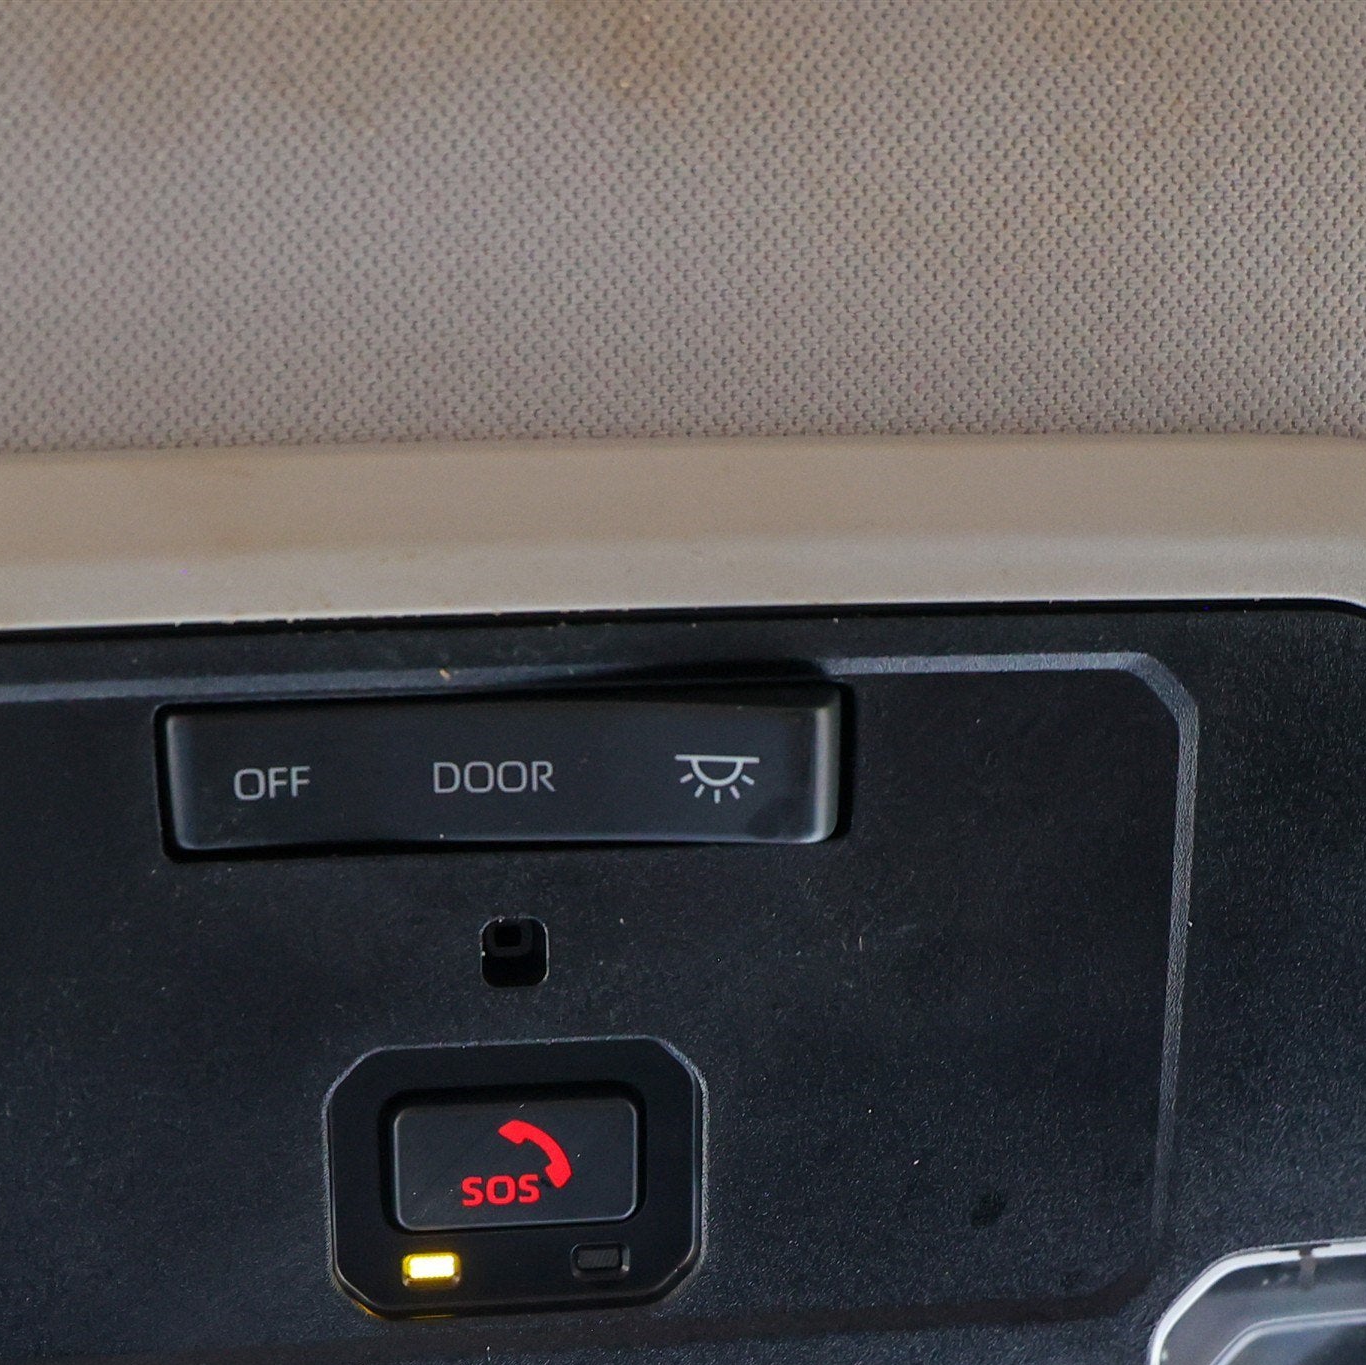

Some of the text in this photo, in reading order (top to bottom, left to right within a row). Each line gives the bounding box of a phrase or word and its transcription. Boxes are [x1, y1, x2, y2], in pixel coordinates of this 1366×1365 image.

[234, 766, 311, 800] OFF
[432, 760, 556, 794] DOOR
[461, 1173, 541, 1207] SOS
